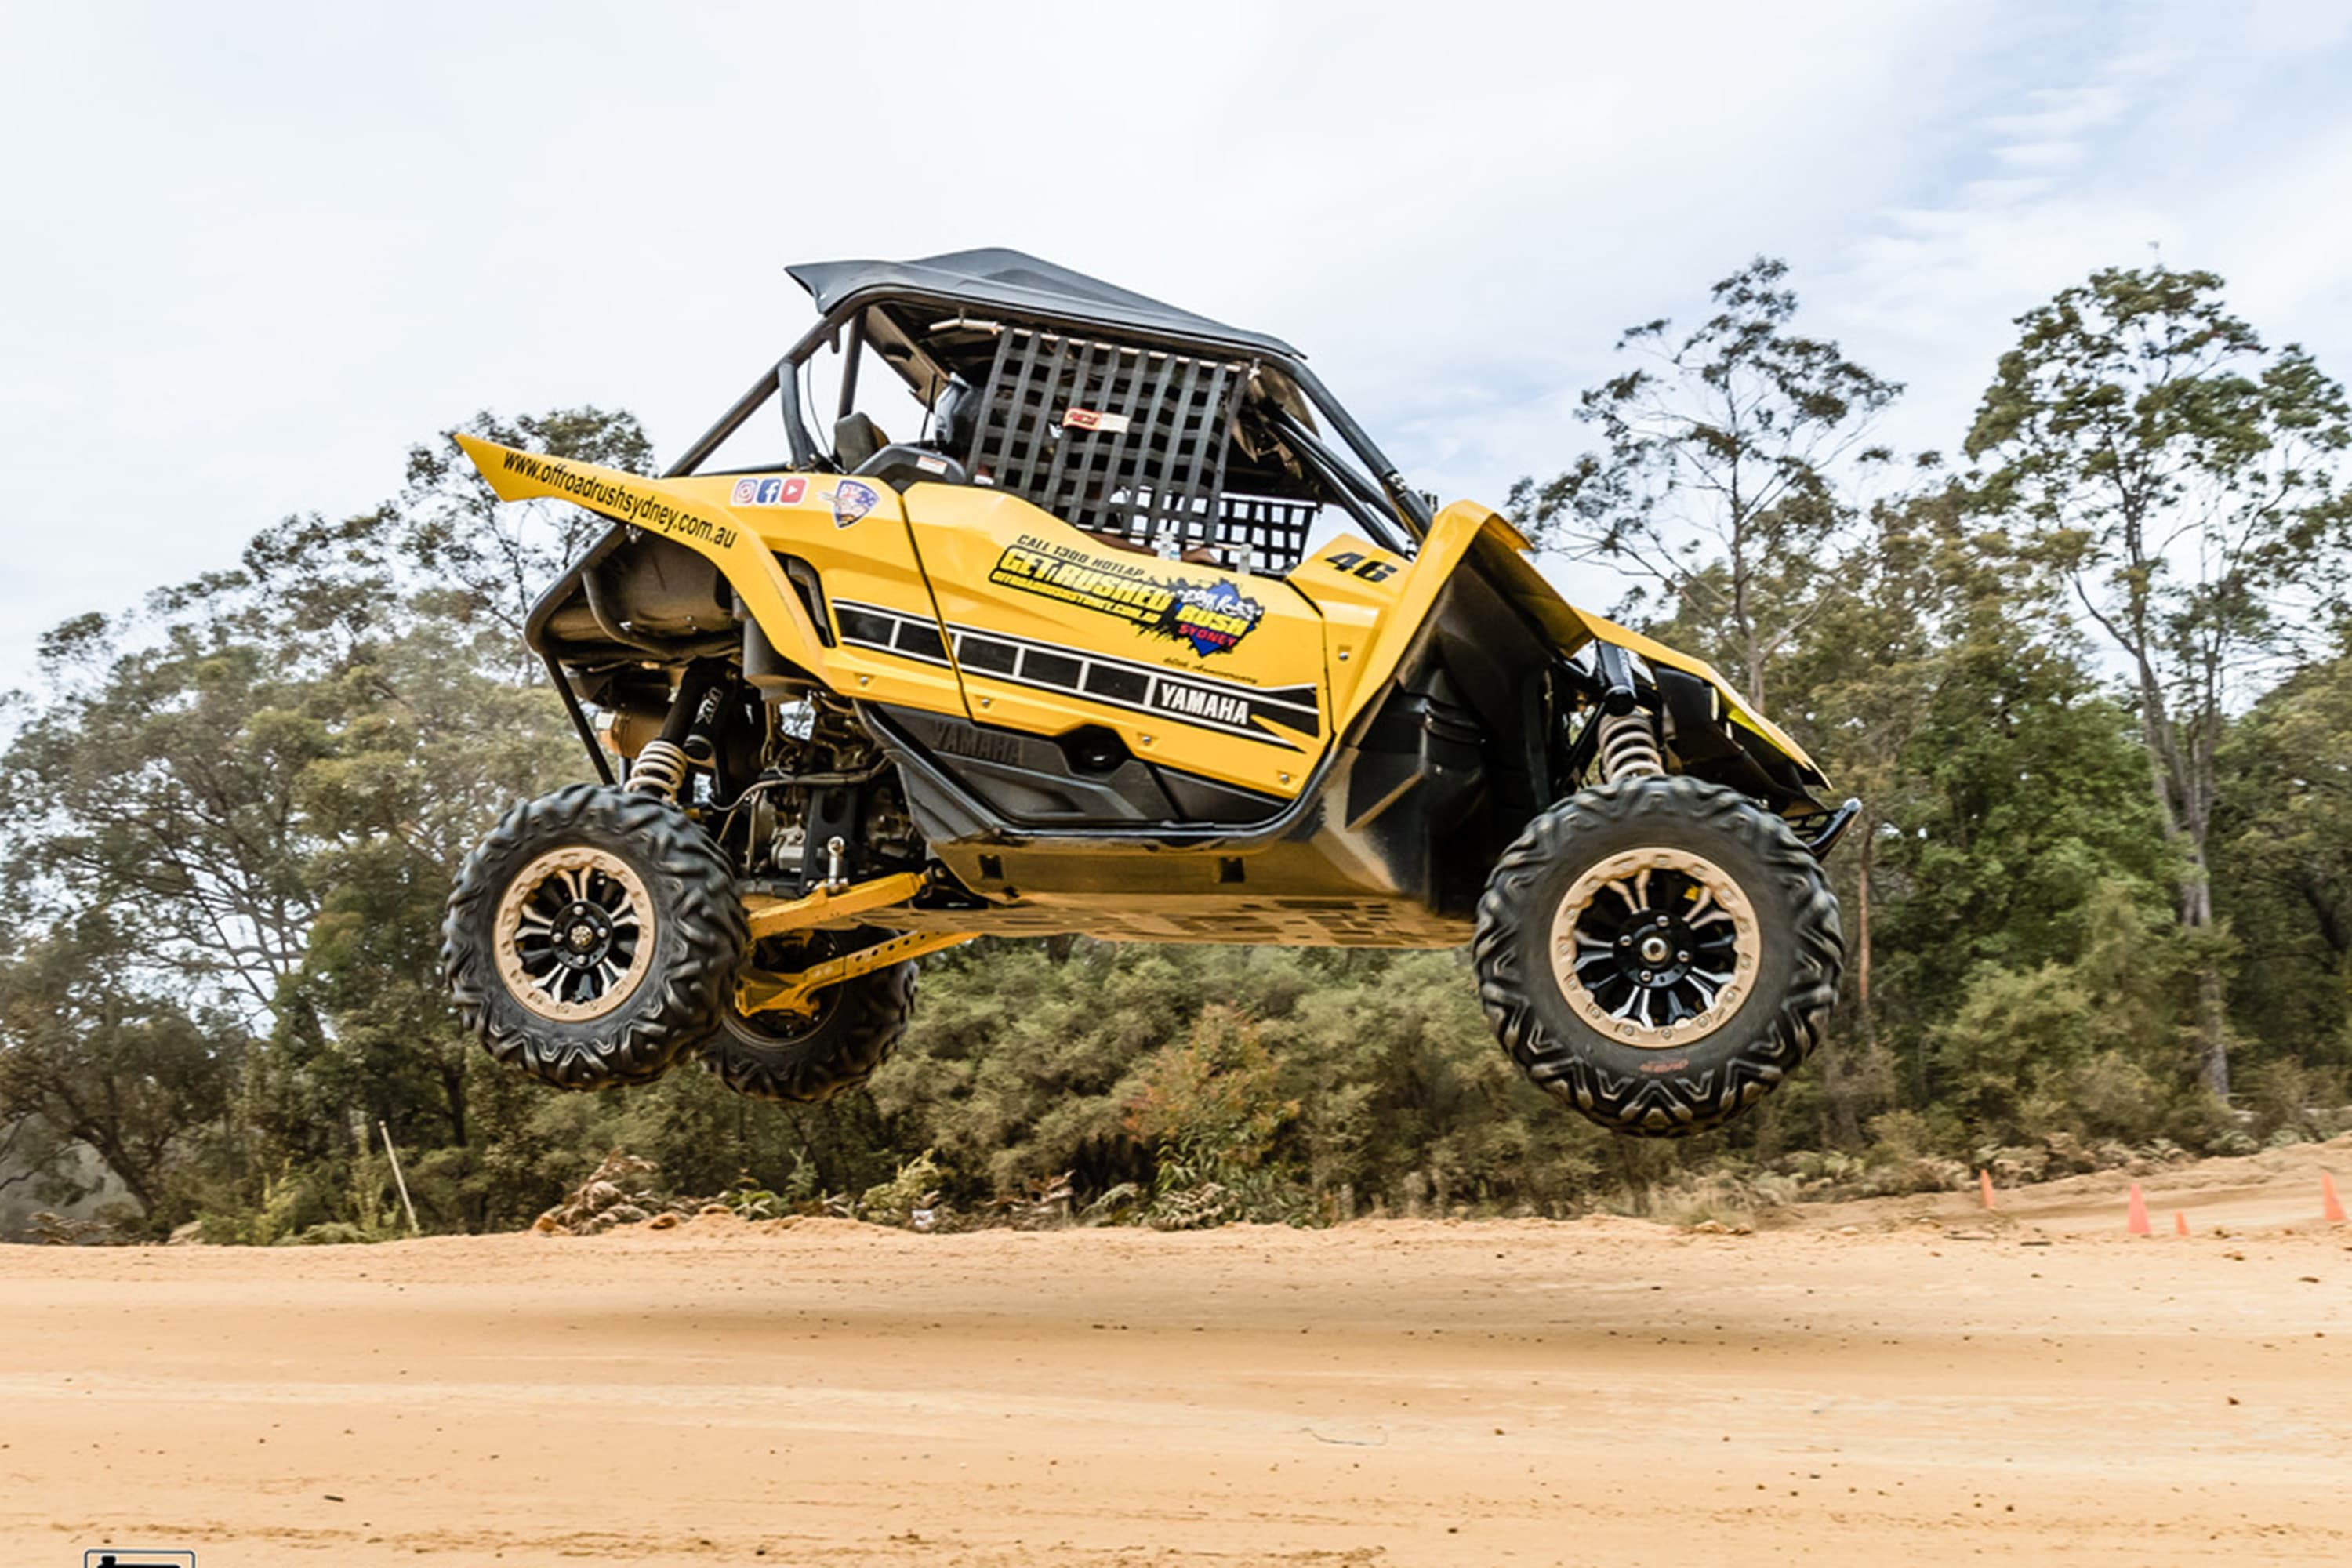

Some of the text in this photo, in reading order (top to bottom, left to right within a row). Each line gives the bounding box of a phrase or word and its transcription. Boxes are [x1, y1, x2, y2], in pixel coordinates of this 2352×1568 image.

[503, 450, 738, 549] www.offroadrushsydney.com.au
[1016, 534, 1051, 551] CALL
[1054, 545, 1091, 564] 1300
[1324, 551, 1398, 583] 46
[1051, 561, 1176, 612] RUSHED
[1174, 604, 1251, 637] RUSH
[1178, 623, 1237, 647] SYDNEY
[1160, 682, 1250, 725] YAMAHA
